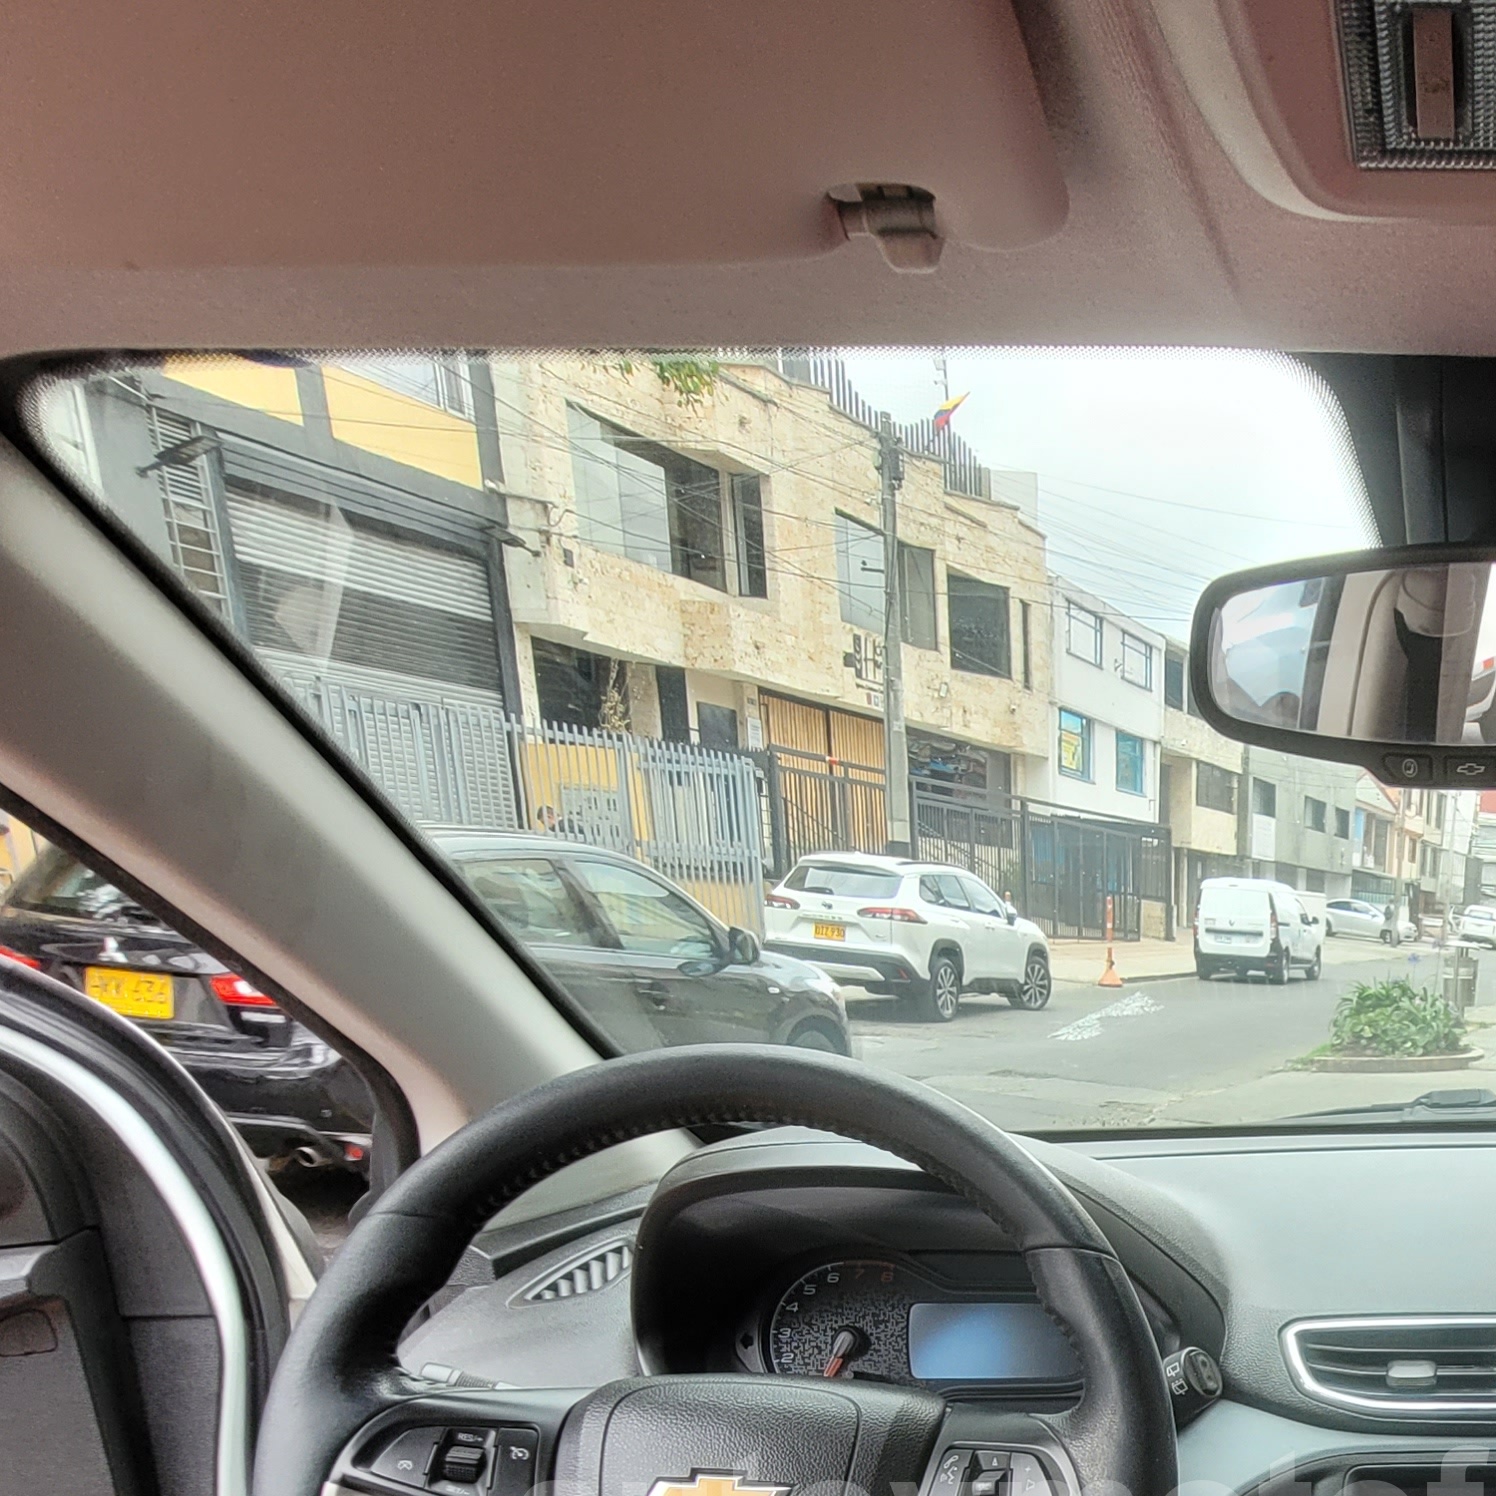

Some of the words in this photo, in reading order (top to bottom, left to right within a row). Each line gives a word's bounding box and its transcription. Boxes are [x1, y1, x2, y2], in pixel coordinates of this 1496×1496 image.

[827, 1272, 840, 1283] 6
[855, 1268, 865, 1279] 7
[881, 1272, 894, 1283] 8
[803, 1284, 817, 1295] 5
[786, 1302, 799, 1313] 4
[778, 1327, 791, 1338] 3
[781, 1352, 794, 1363] 2
